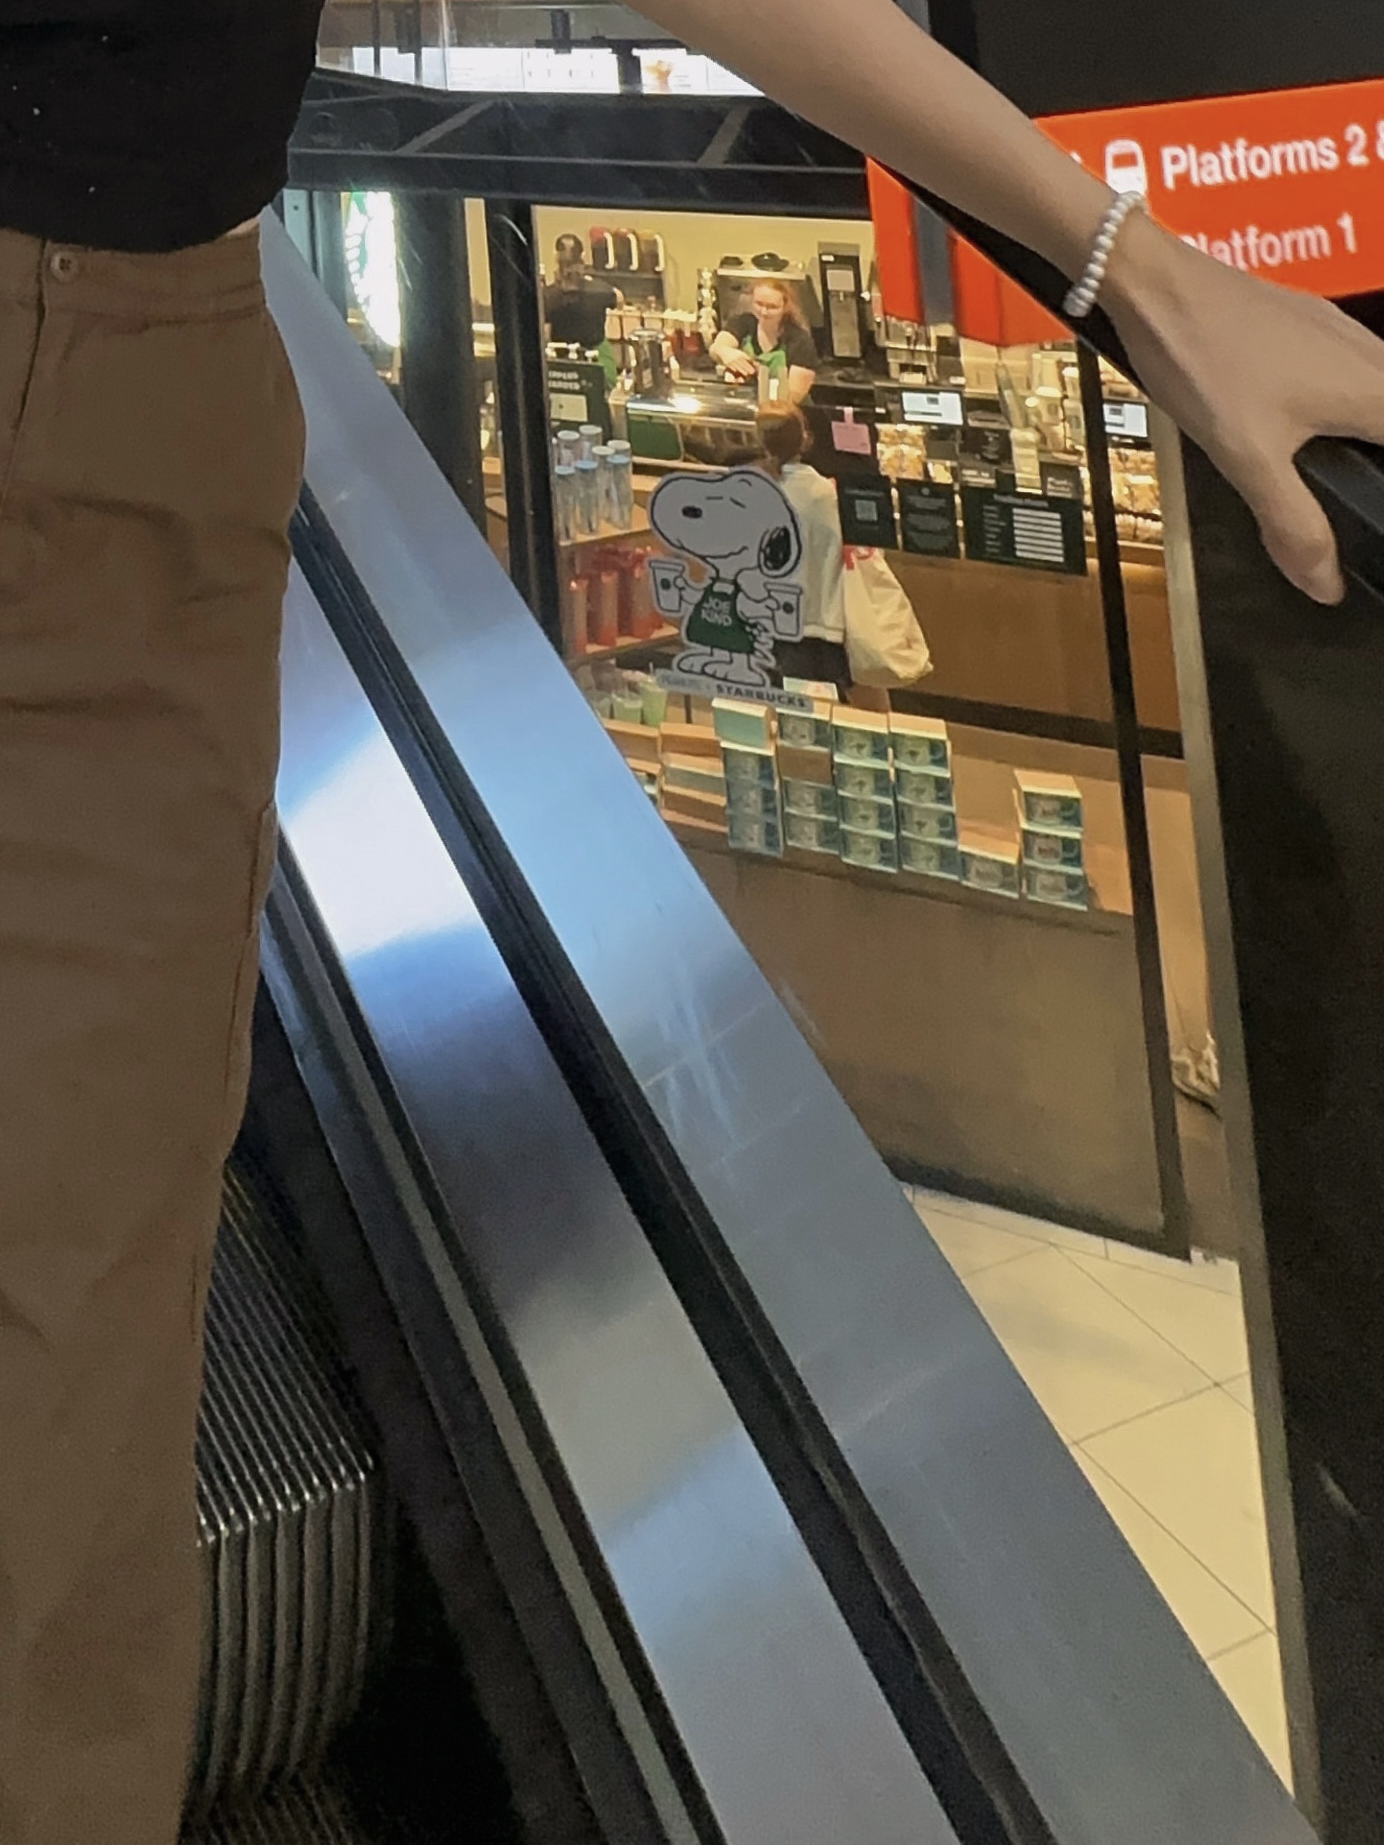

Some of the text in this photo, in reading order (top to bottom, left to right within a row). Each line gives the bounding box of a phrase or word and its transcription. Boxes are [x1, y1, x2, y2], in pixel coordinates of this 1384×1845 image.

[1161, 137, 1340, 191] Platforms
[1344, 123, 1369, 167] 2
[1336, 211, 1358, 254] 1
[715, 683, 807, 709] STARBUCKS
